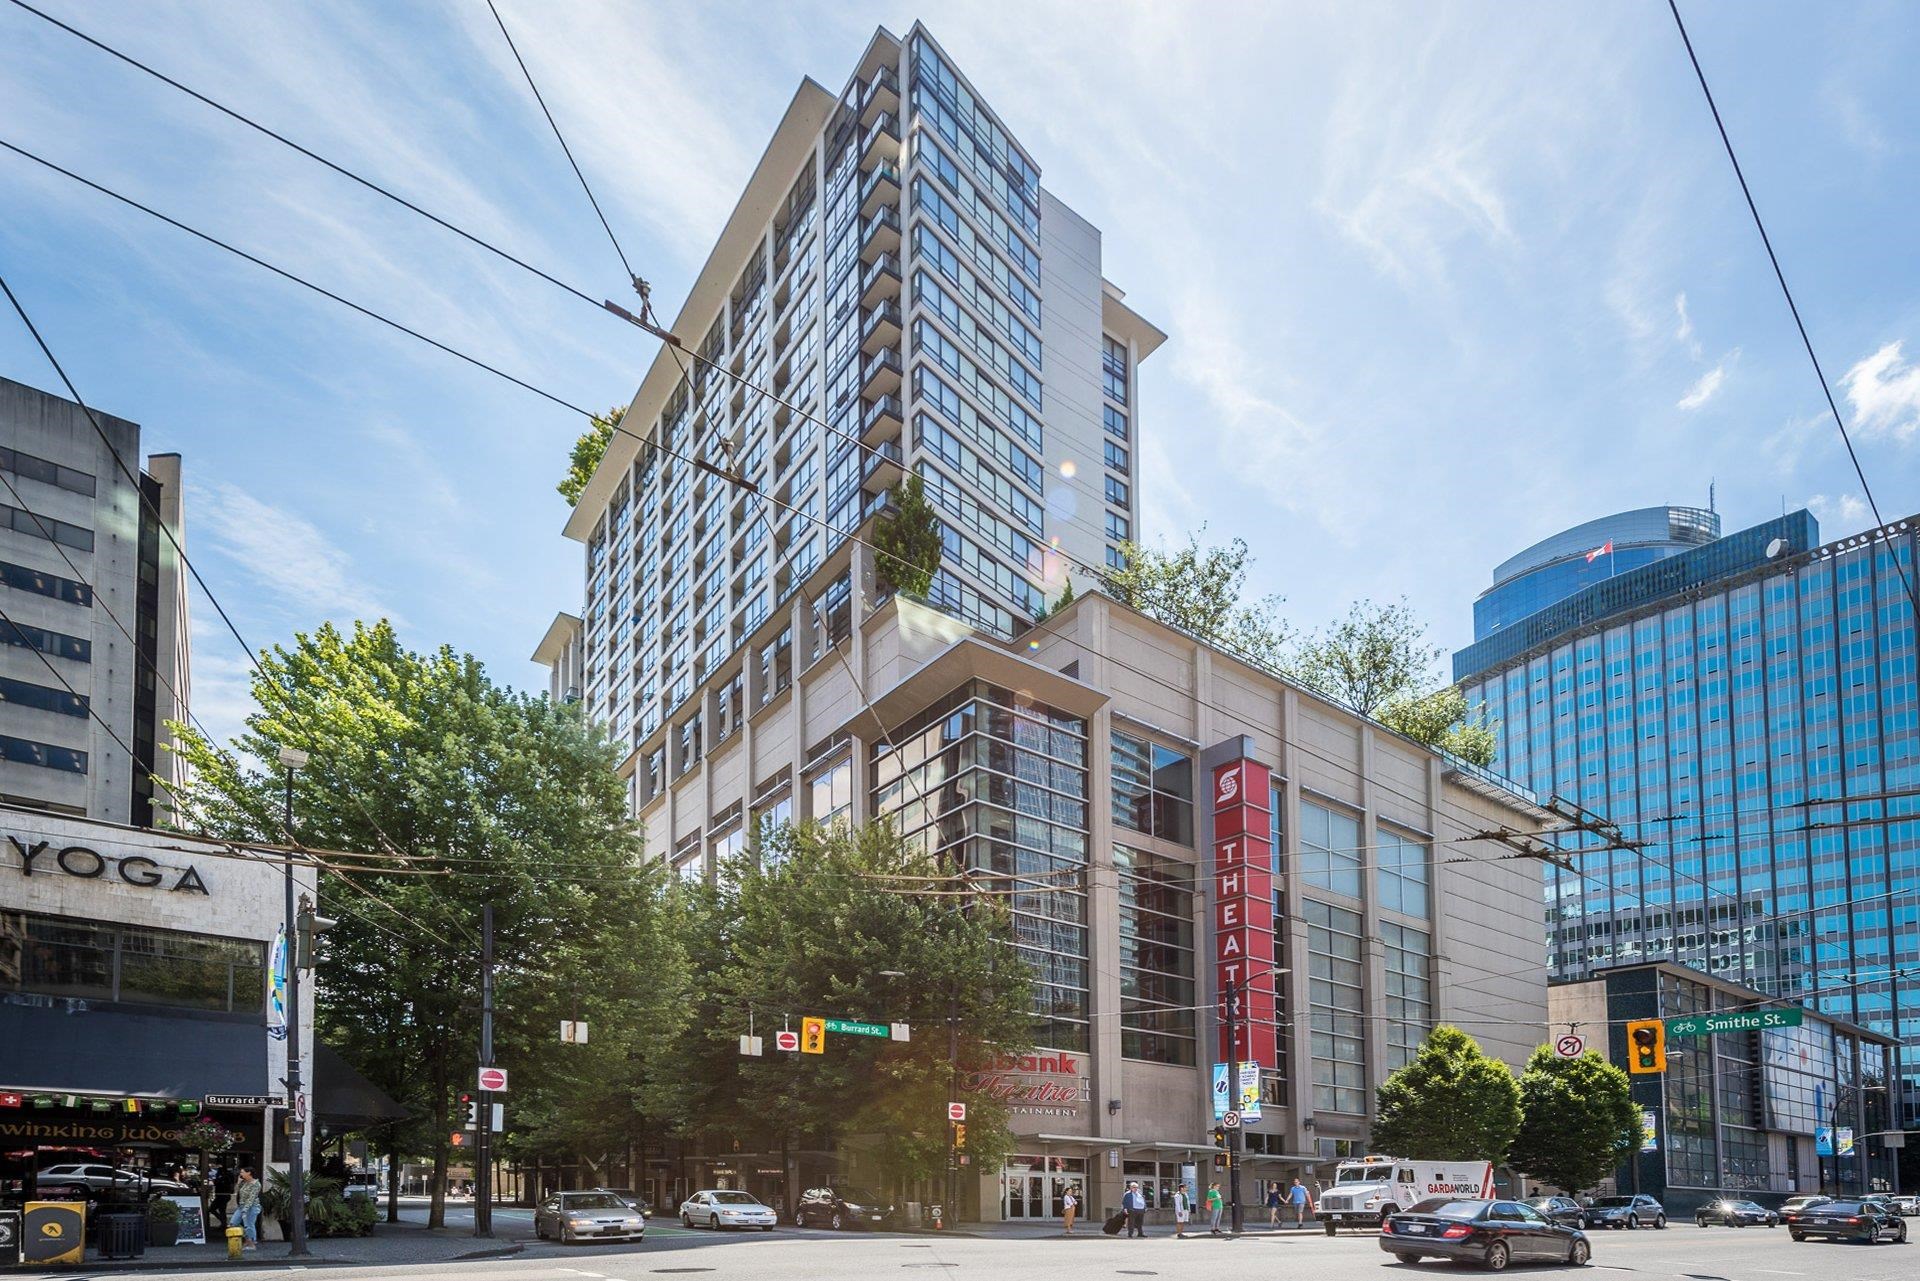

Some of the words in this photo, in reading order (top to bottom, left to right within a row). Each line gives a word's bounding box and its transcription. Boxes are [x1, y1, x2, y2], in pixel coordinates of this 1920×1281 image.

[7, 835, 210, 896] YOGA
[1706, 1016, 1760, 1031] Smithe
[1764, 1013, 1787, 1026] St.
[841, 1023, 870, 1035] Burrard
[871, 1027, 882, 1035] St.
[209, 1096, 255, 1104] Burrard
[1006, 1107, 1077, 1117] TAINMENT
[120, 1124, 182, 1142] judg
[1428, 1183, 1480, 1194] GARDAWORLD
